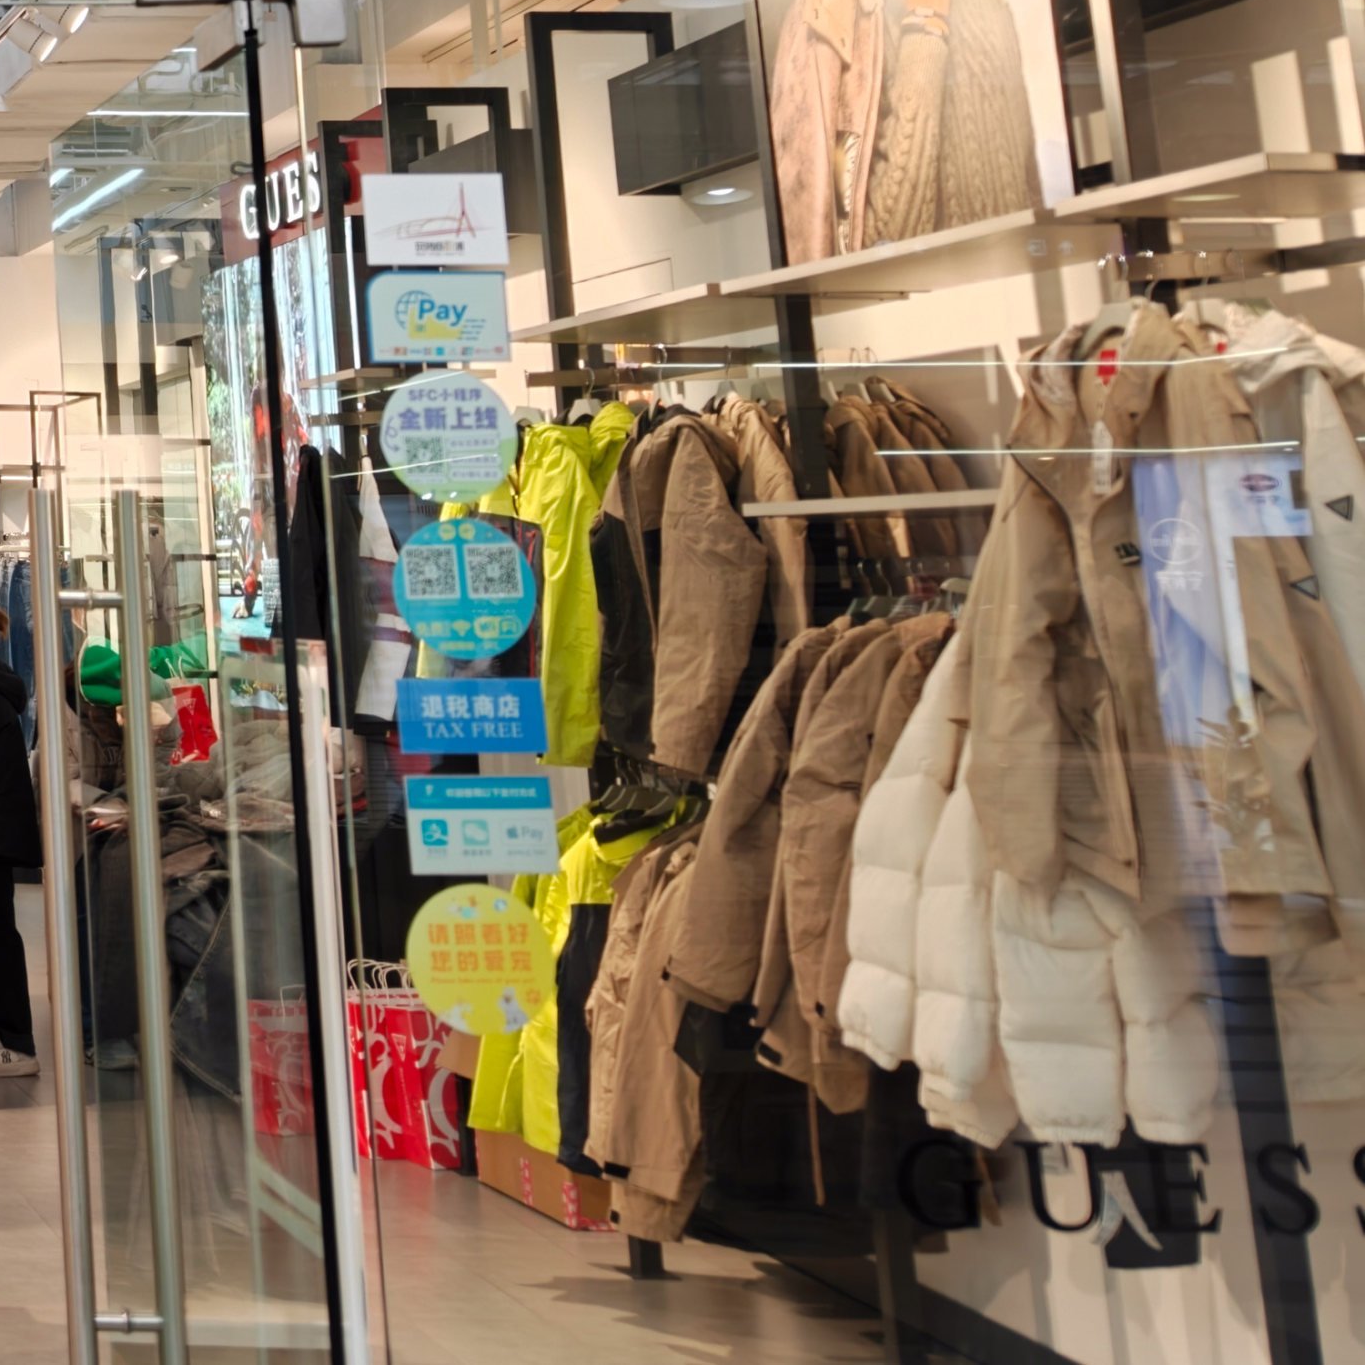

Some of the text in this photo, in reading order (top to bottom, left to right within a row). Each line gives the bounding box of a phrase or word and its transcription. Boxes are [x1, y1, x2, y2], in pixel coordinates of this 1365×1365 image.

[240, 151, 320, 240] GUES
[419, 299, 468, 327] Pay
[398, 406, 498, 430] 全新上线
[422, 694, 520, 719] 退税商店
[424, 722, 523, 739] TAX FREE
[428, 923, 529, 945] 请照看好
[897, 1140, 1365, 1235] GUES
